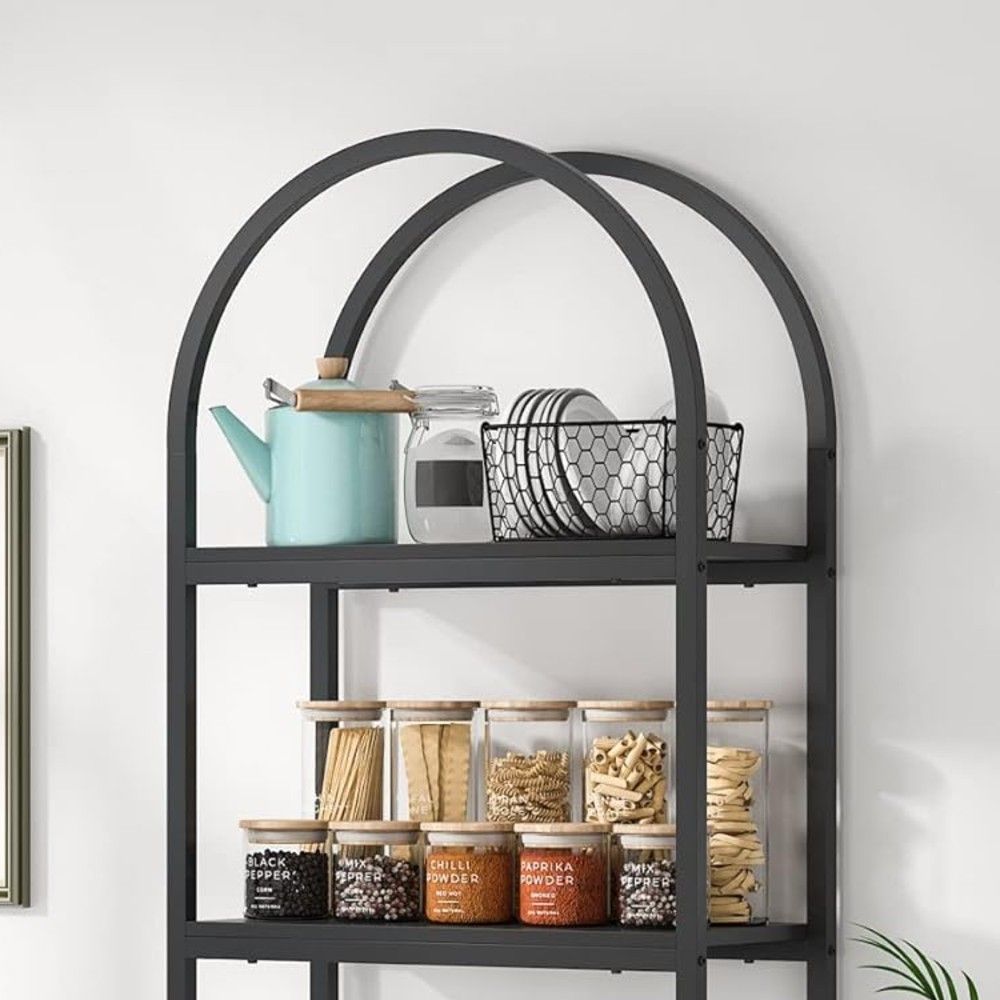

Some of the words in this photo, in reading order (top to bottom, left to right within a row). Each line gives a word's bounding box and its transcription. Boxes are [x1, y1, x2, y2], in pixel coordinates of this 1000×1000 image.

[246, 857, 286, 868] BLACK
[430, 860, 471, 871] CHILLI
[520, 861, 574, 872] PAPRIKA
[631, 863, 654, 875] MIX
[426, 873, 480, 884] POWDER
[520, 874, 575, 886] POWDER
